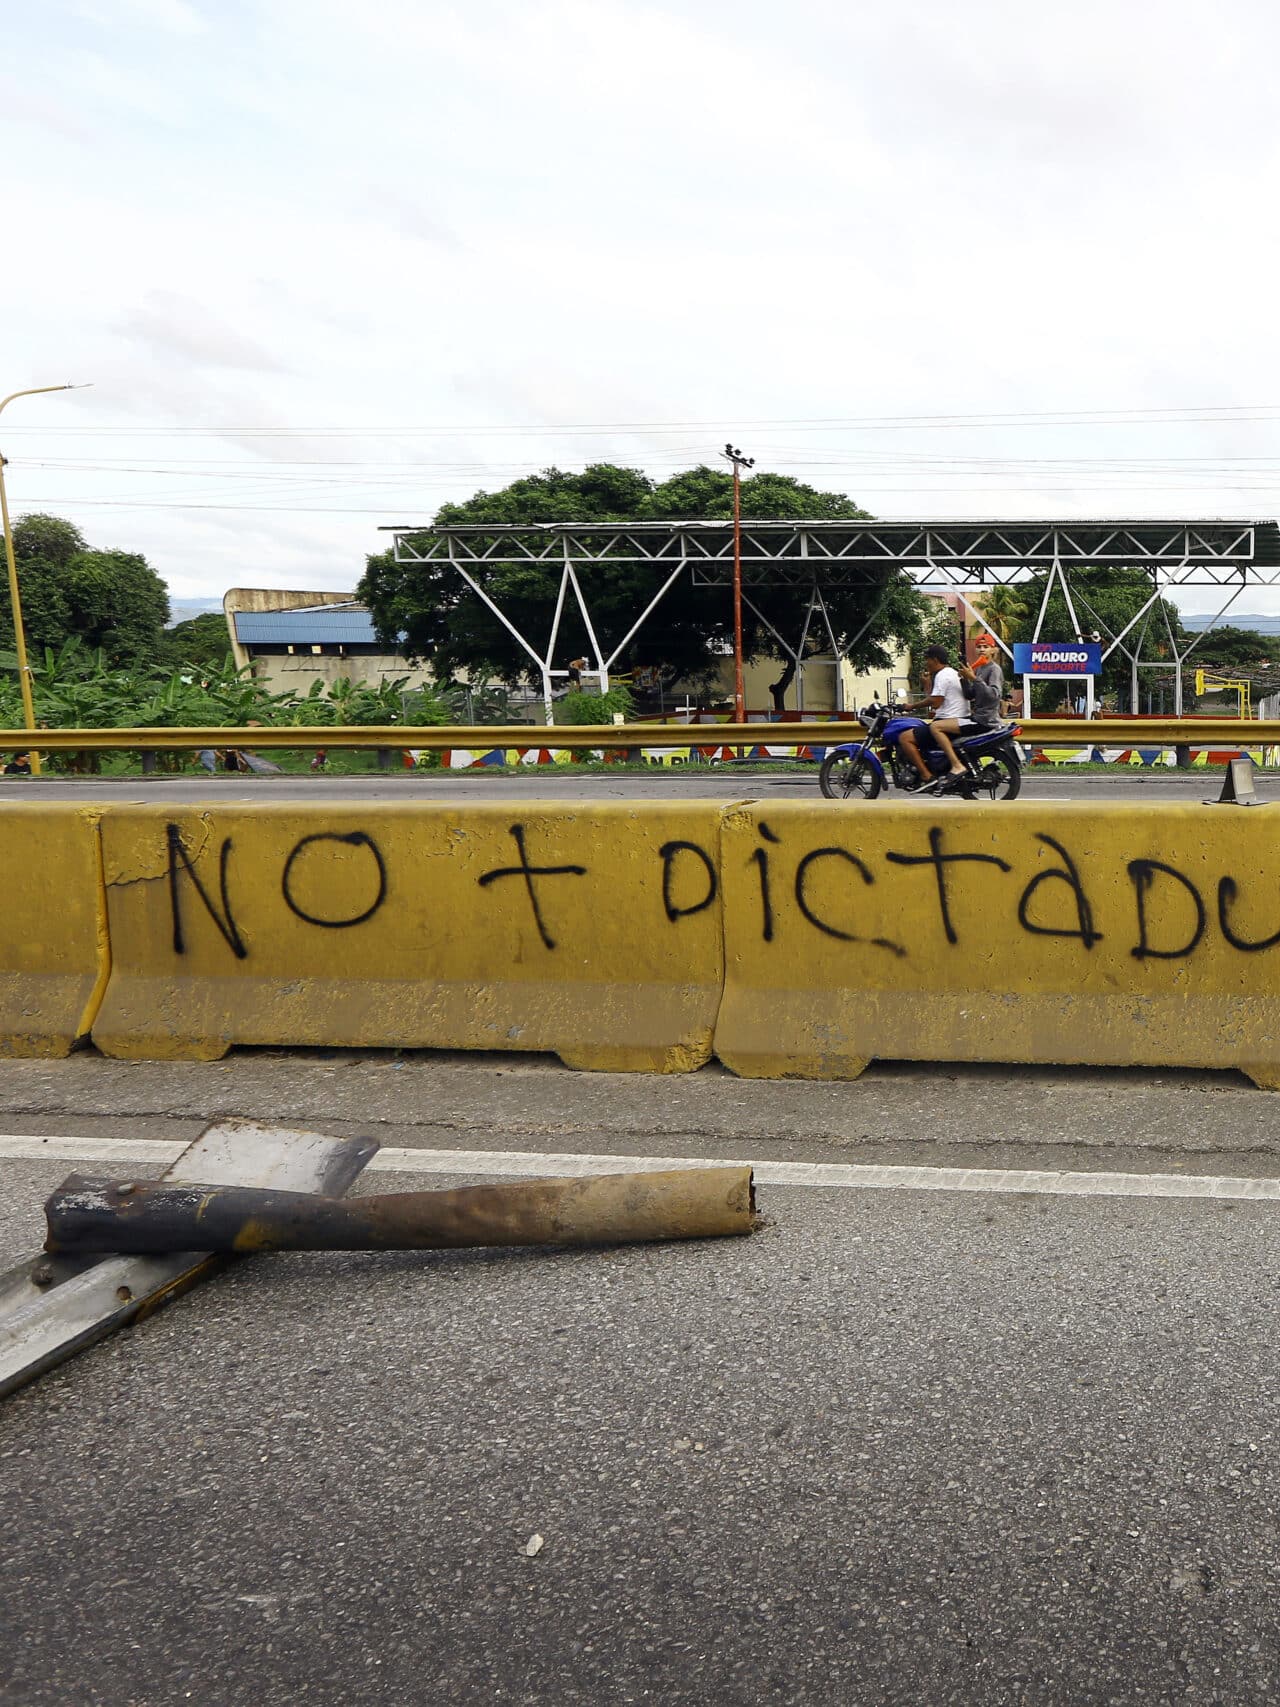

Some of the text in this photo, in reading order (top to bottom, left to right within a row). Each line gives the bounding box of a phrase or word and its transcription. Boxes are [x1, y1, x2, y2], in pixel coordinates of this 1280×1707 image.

[1031, 651, 1088, 663] MADURO
[166, 823, 388, 961] NO
[477, 822, 588, 949] +
